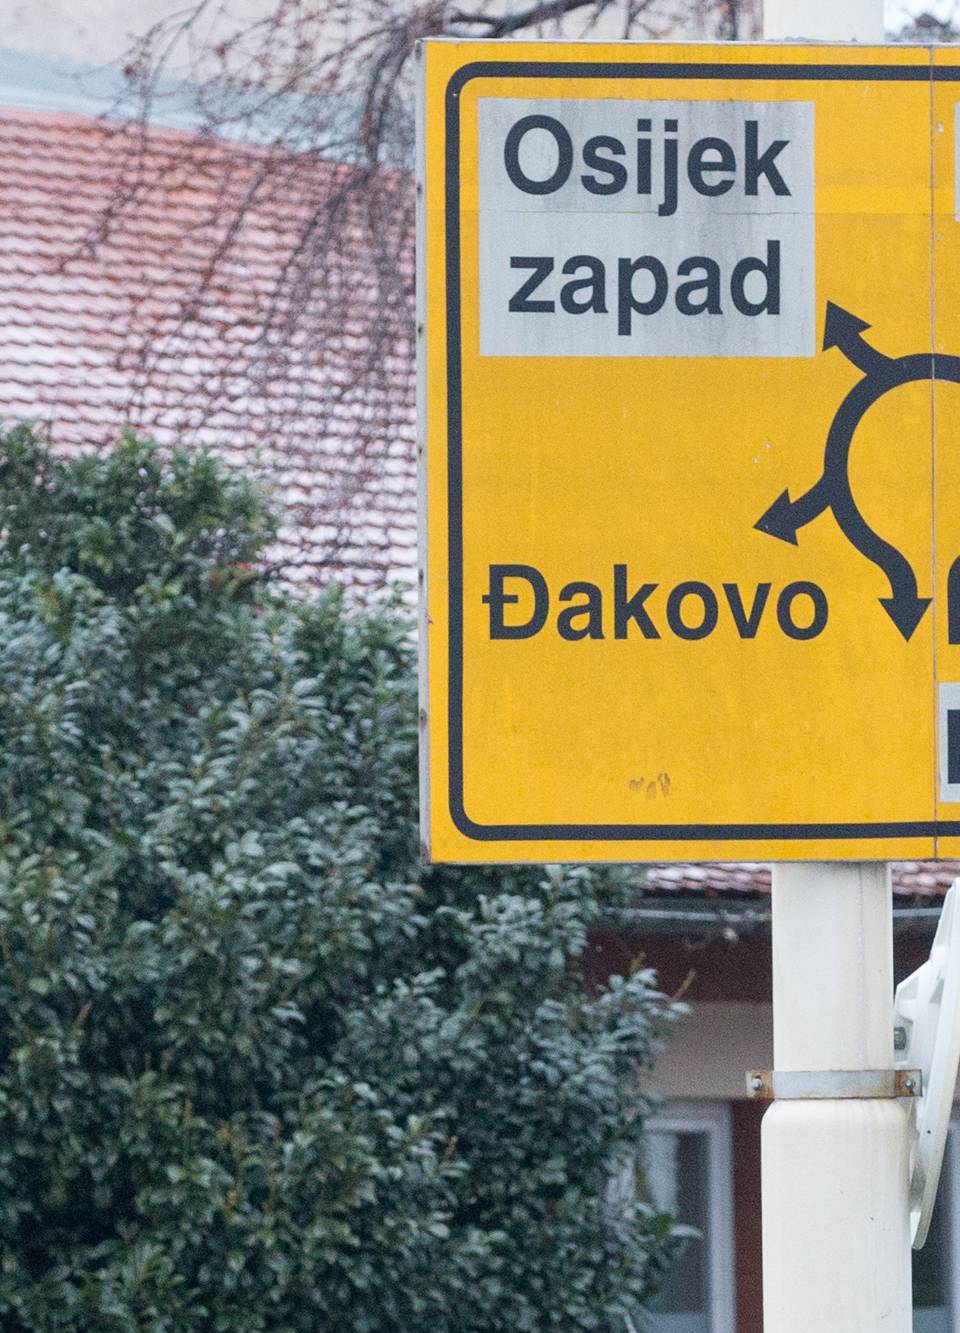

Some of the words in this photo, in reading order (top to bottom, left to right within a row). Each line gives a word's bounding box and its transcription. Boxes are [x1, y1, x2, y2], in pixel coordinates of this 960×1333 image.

[503, 115, 791, 217] Osijek
[508, 239, 782, 336] zapad
[482, 563, 830, 642] Đakovo
